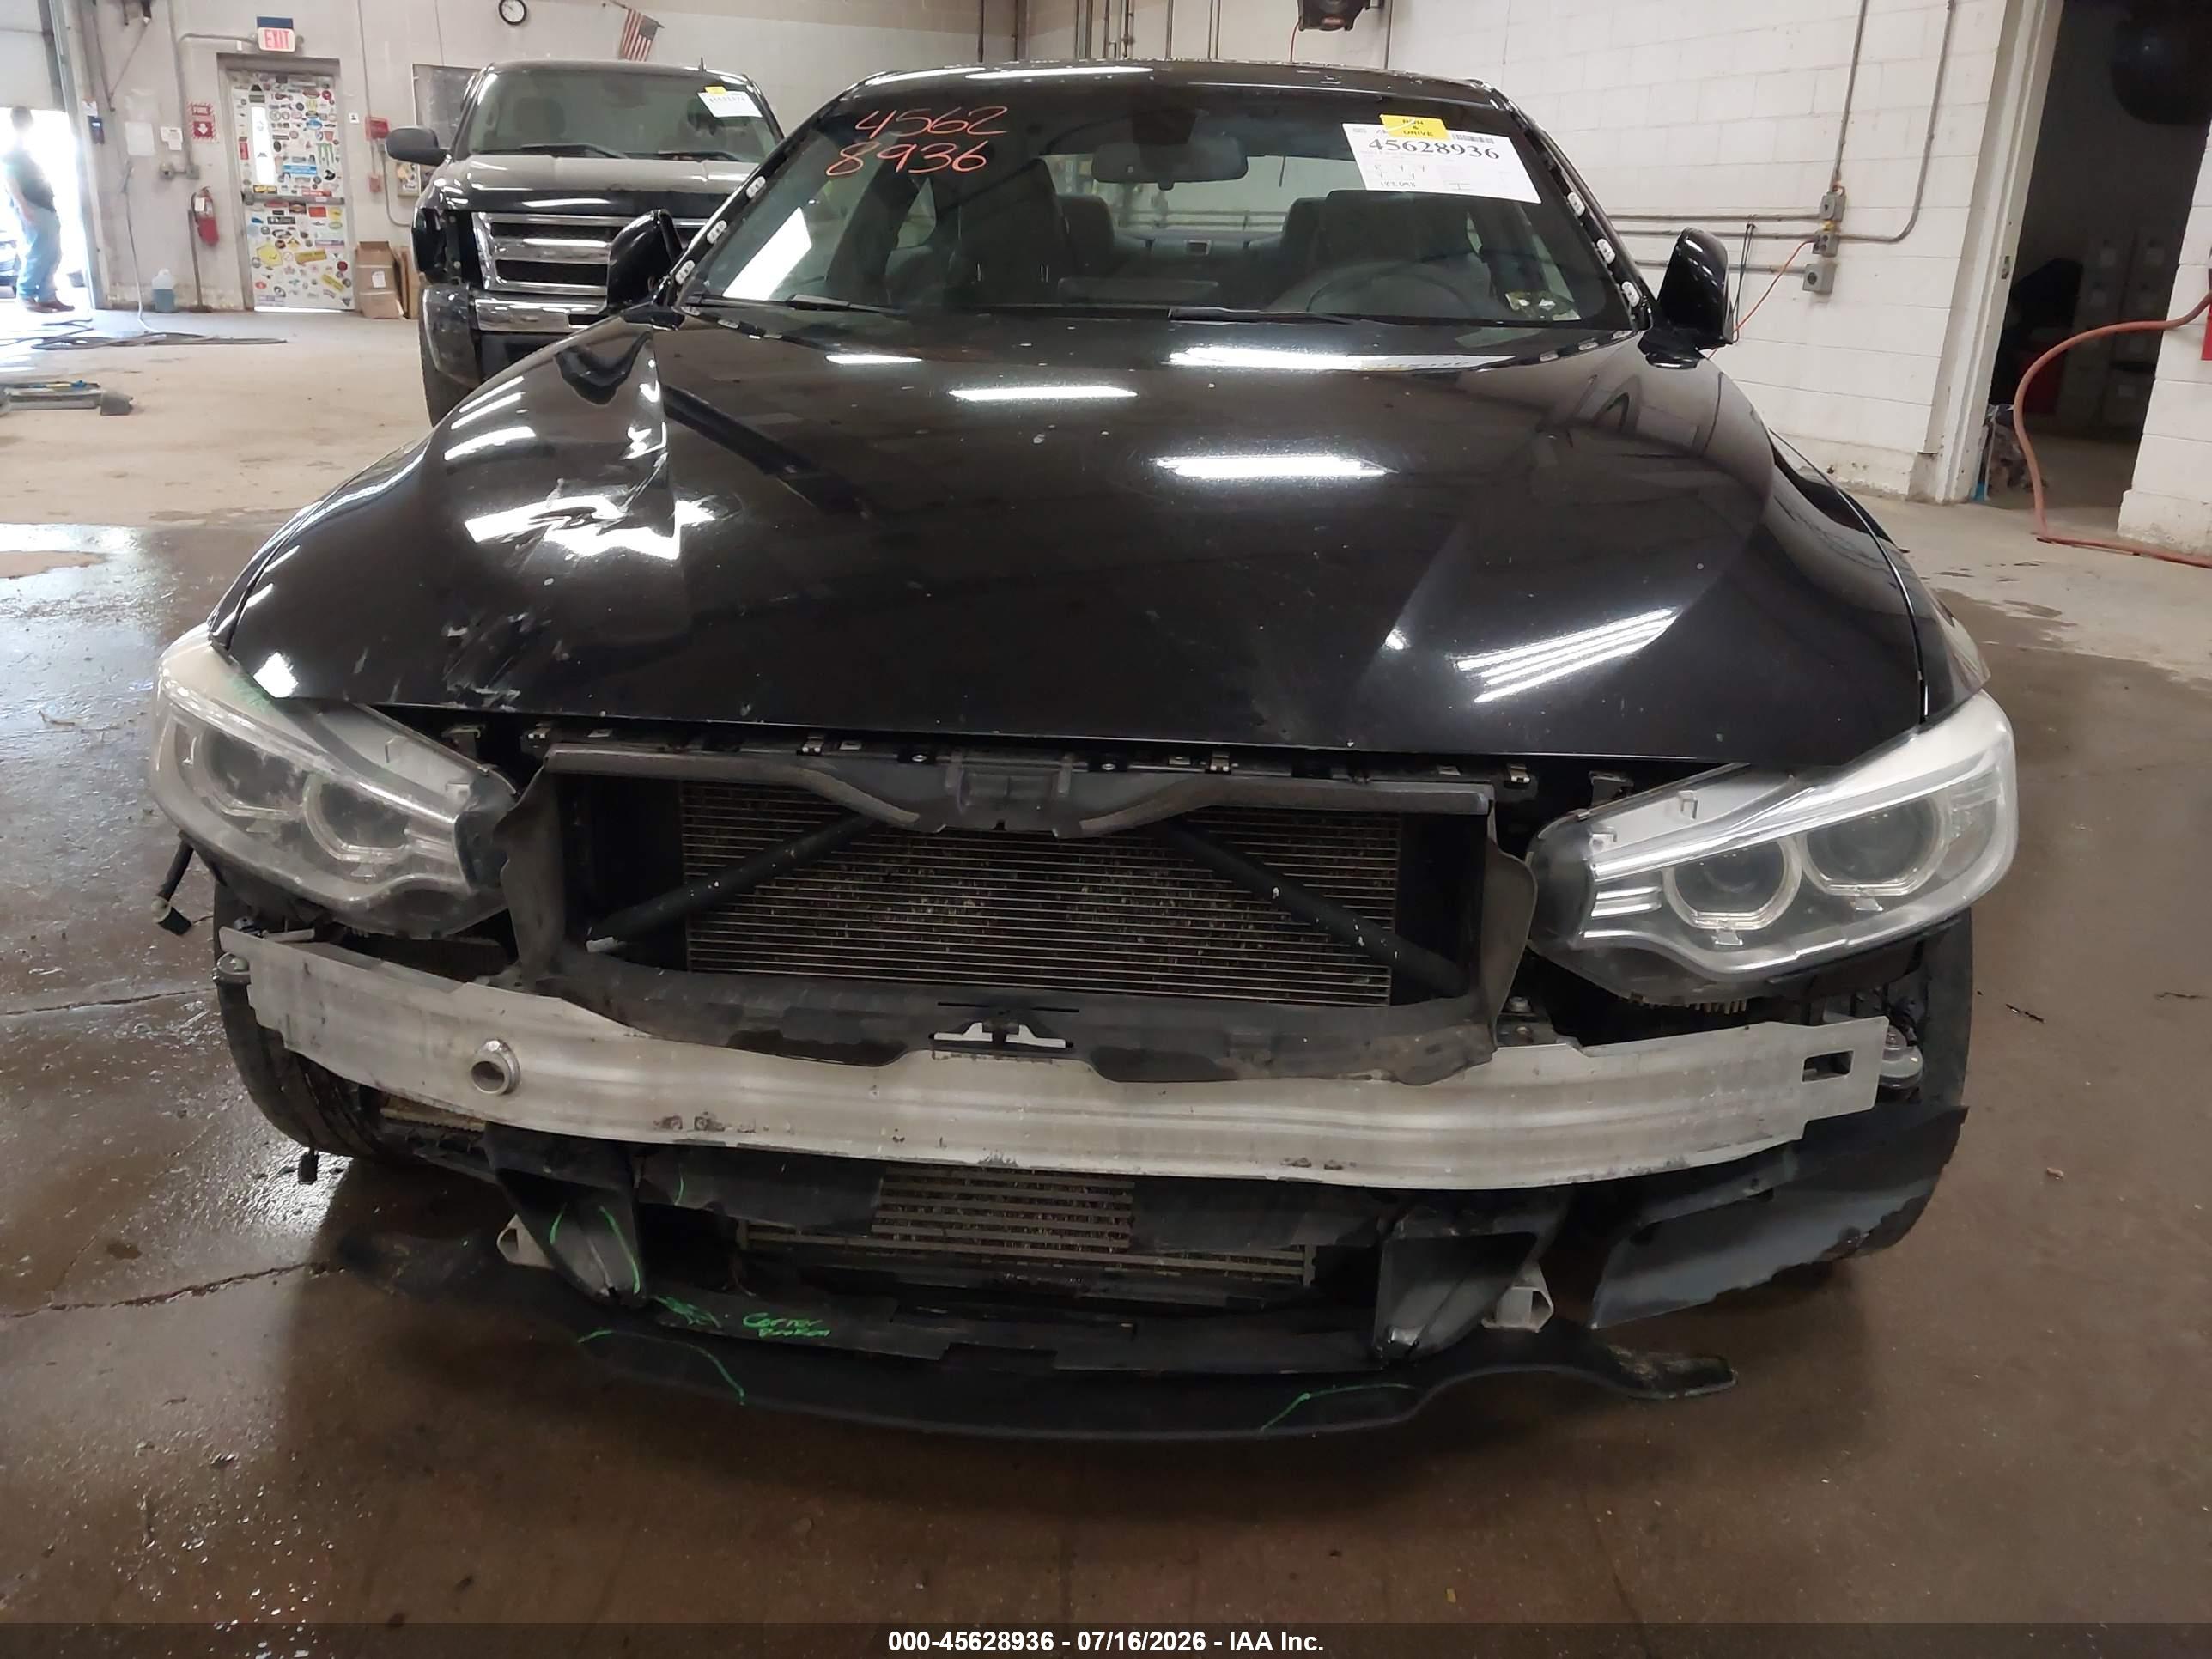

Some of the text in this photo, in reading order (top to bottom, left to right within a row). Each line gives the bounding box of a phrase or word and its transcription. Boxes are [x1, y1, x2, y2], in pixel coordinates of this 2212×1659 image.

[264, 28, 290, 50] EXIT
[855, 106, 1008, 138] 4562
[825, 140, 989, 176] 8936
[1368, 137, 1500, 160] 45628936
